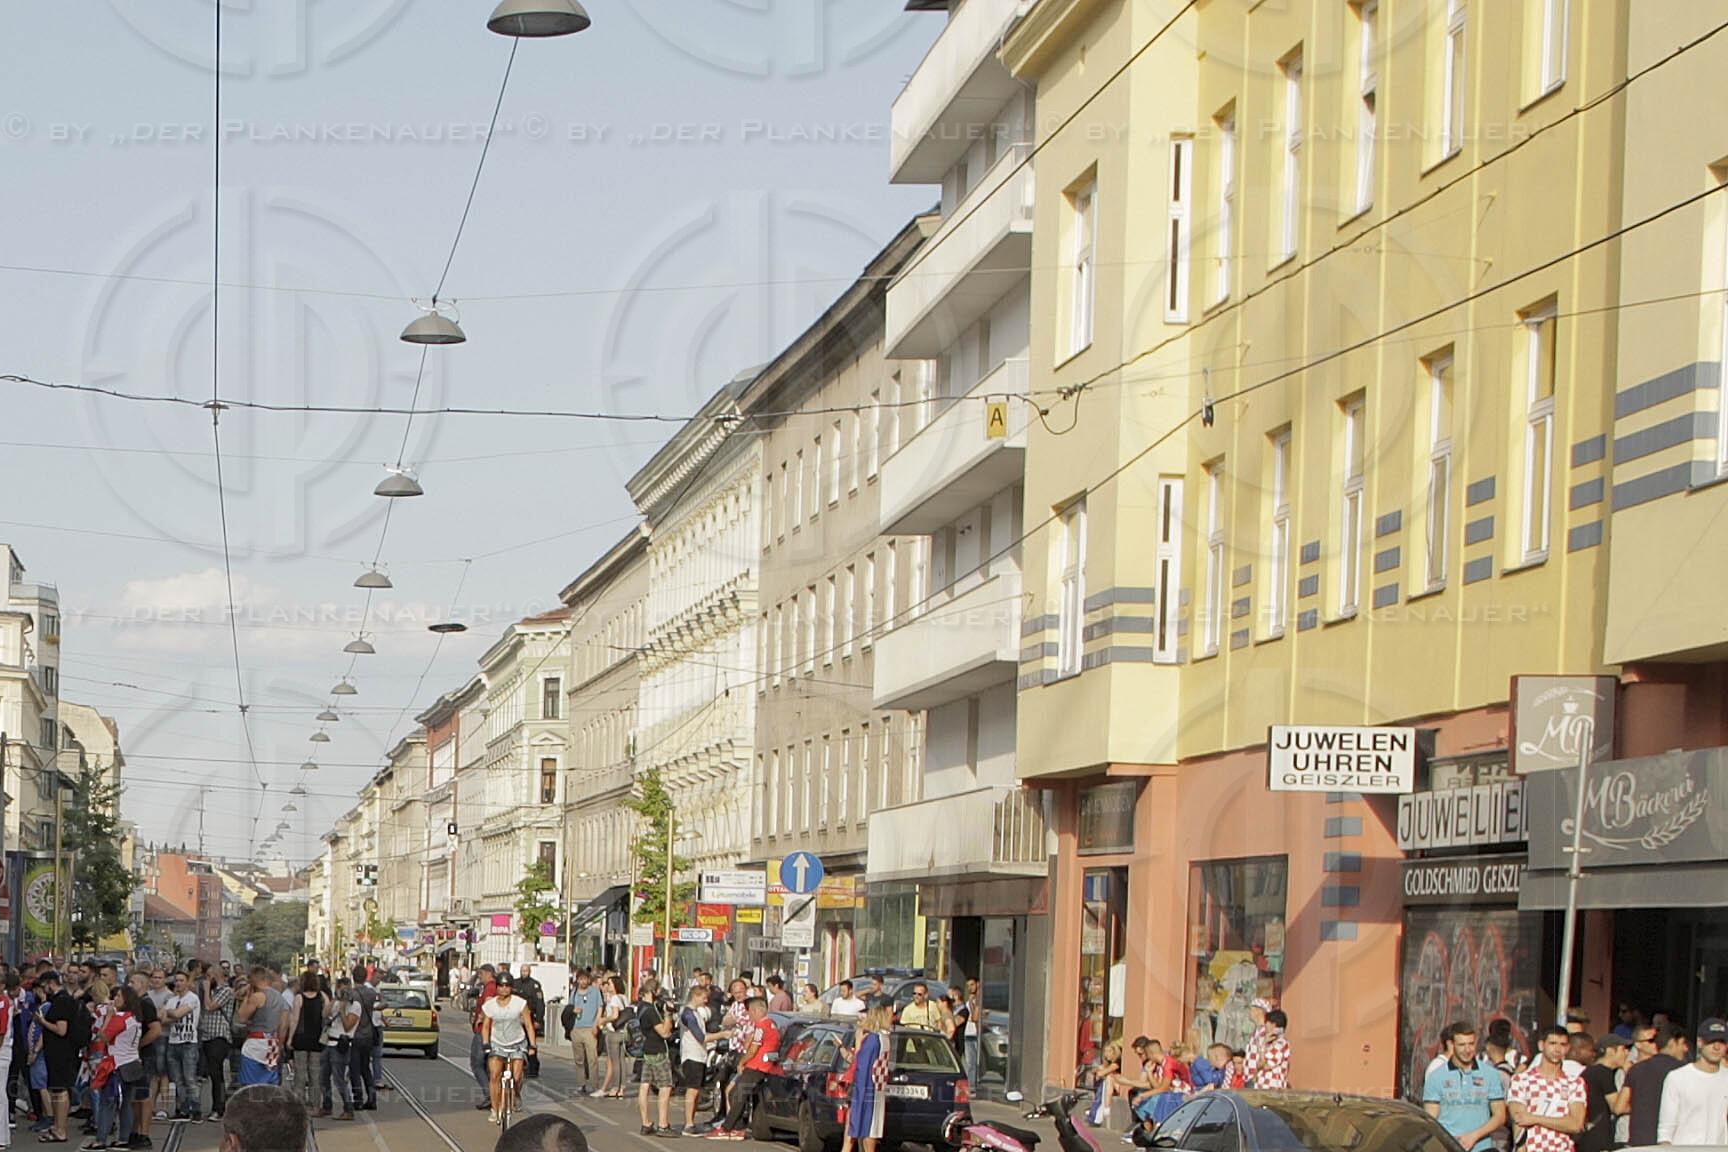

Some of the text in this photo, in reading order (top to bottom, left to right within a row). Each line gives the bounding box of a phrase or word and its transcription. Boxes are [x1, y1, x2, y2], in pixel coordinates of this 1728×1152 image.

[989, 407, 1004, 428] A
[1276, 732, 1407, 752] JUWELEN
[1293, 753, 1392, 773] UHREN
[1282, 773, 1401, 787] GEISZLER
[1399, 787, 1527, 844] JUWELIE
[1404, 863, 1522, 896] GOLDSCHMIED GEISZL
